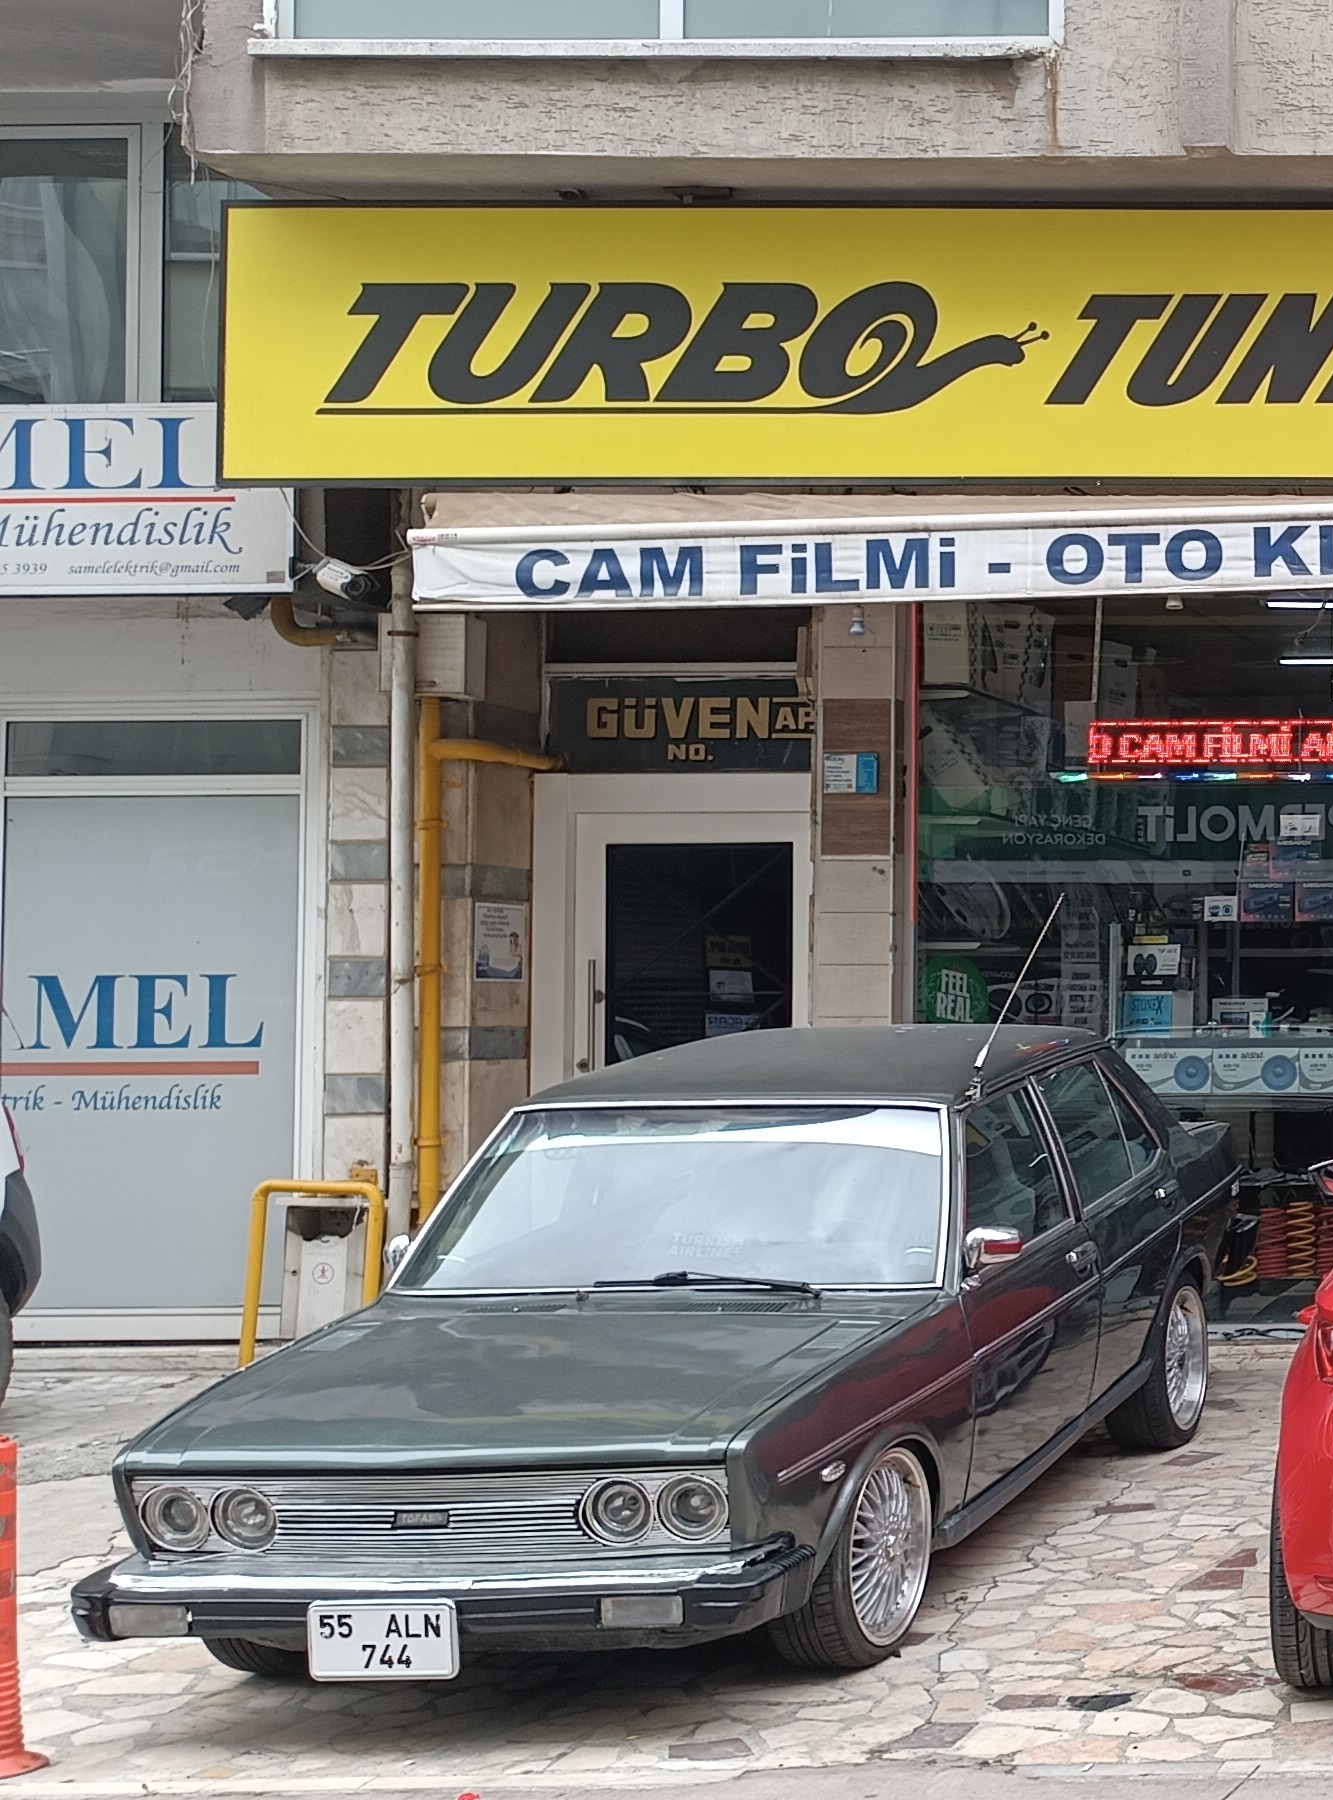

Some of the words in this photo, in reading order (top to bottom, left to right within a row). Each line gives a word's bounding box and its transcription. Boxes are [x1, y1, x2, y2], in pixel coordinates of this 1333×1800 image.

[323, 280, 940, 414] TURBO
[14, 562, 48, 575] 3939
[515, 546, 703, 600] CAM
[1045, 530, 1224, 585] OTO
[586, 697, 773, 740] GÜVEN
[1119, 734, 1197, 758] CAM
[940, 968, 969, 996] FEEL
[935, 991, 974, 1023] REAL
[72, 1084, 224, 1112] Mühendislik
[319, 1614, 353, 1639] 55
[385, 1613, 441, 1638] ALN
[362, 1644, 412, 1669] 744
